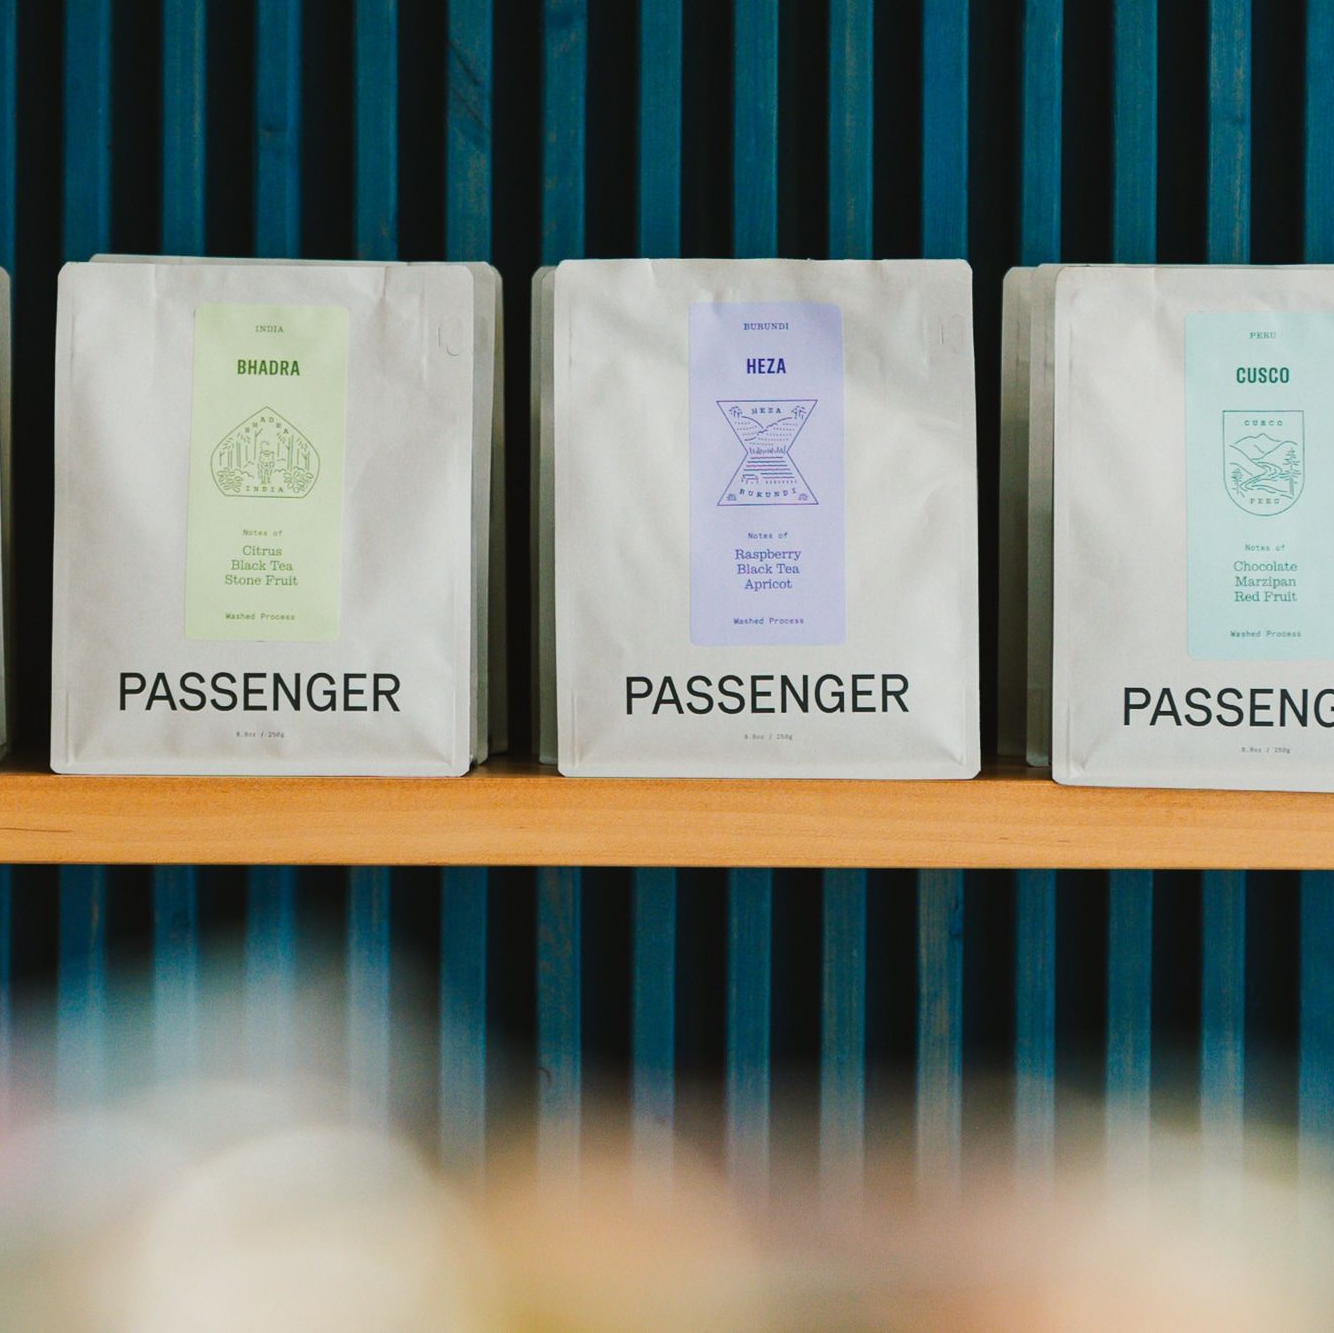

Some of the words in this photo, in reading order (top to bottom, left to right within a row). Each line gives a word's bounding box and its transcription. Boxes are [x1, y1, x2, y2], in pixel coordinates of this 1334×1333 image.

[255, 325, 284, 333] INDIA
[237, 359, 301, 377] BHADRA
[746, 357, 787, 375] HEZA
[1236, 366, 1290, 384] CUSCO
[242, 544, 283, 557] Citrus
[734, 548, 802, 563] Raspberry
[230, 558, 267, 571] Black
[269, 559, 294, 572] Tea
[736, 563, 773, 575] Black
[775, 562, 801, 575] Tea
[1233, 560, 1298, 572] Chocolate
[224, 573, 262, 586] Stone
[265, 574, 299, 587] Fruit
[744, 578, 793, 592] Apricot
[1234, 575, 1297, 590] Marzipan
[1234, 590, 1261, 603] Red
[1263, 590, 1297, 603] Fruit
[225, 612, 256, 620] Washed
[260, 612, 295, 621] Process
[119, 671, 401, 713] PASSENGER
[625, 673, 909, 716] PASSENGER
